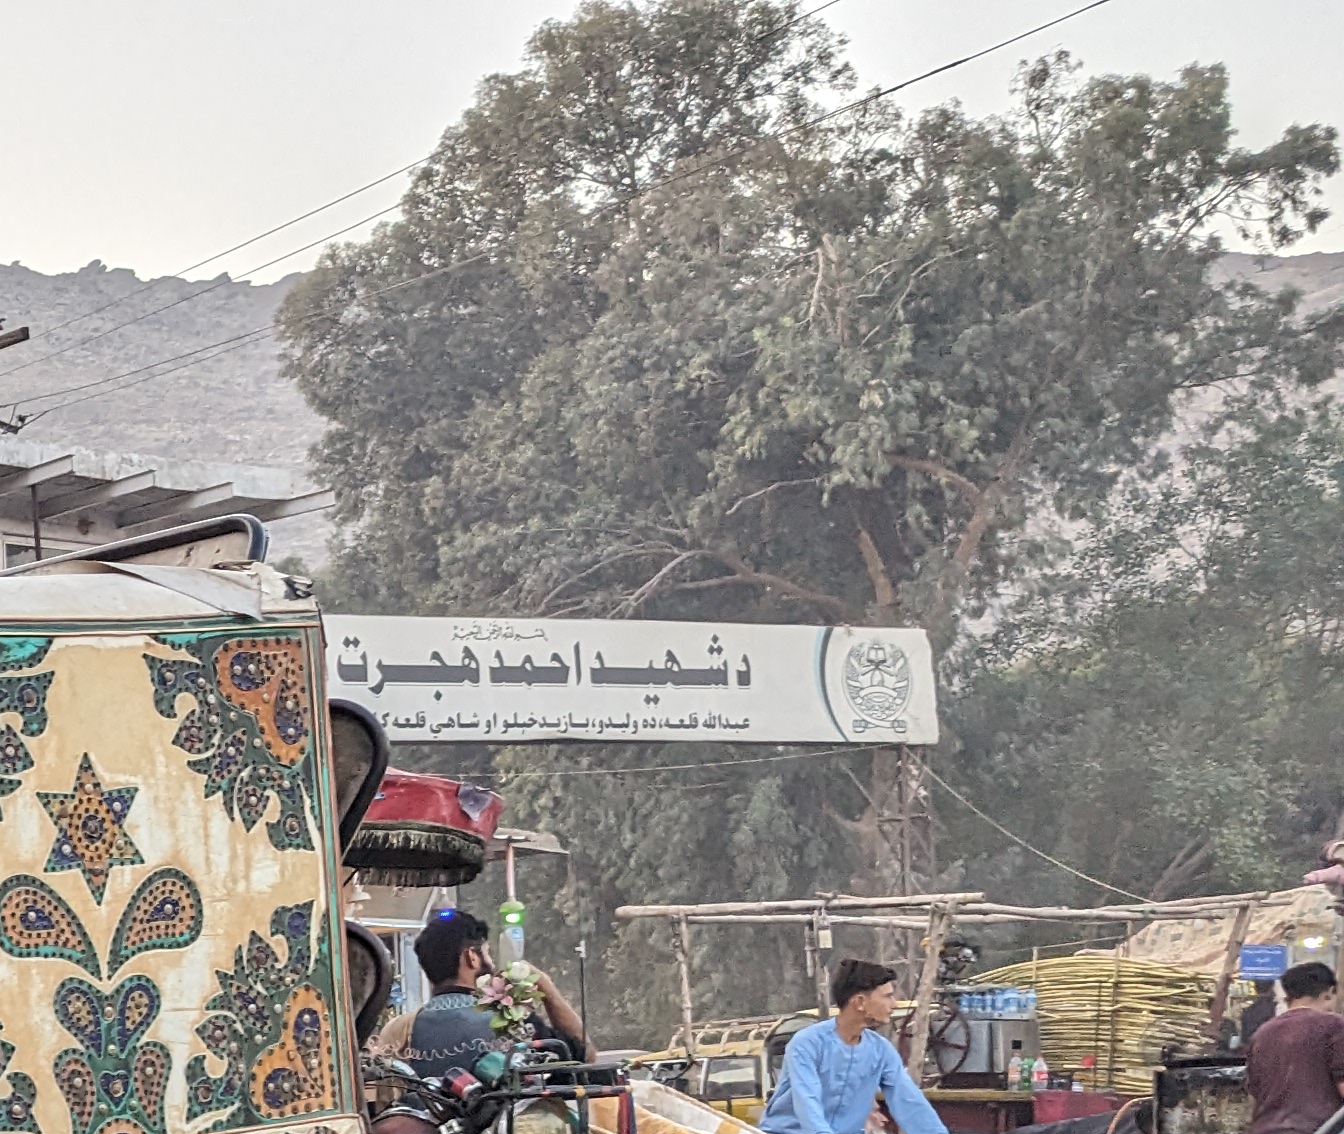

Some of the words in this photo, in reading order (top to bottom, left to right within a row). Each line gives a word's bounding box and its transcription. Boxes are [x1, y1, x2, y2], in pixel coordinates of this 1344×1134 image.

[336, 635, 481, 703] هجرت
[488, 640, 583, 687] احمد
[589, 633, 729, 706] شهید
[735, 653, 752, 687] د
[391, 710, 427, 730] قلعه
[483, 712, 498, 735] او
[702, 708, 750, 734] عبدالله
